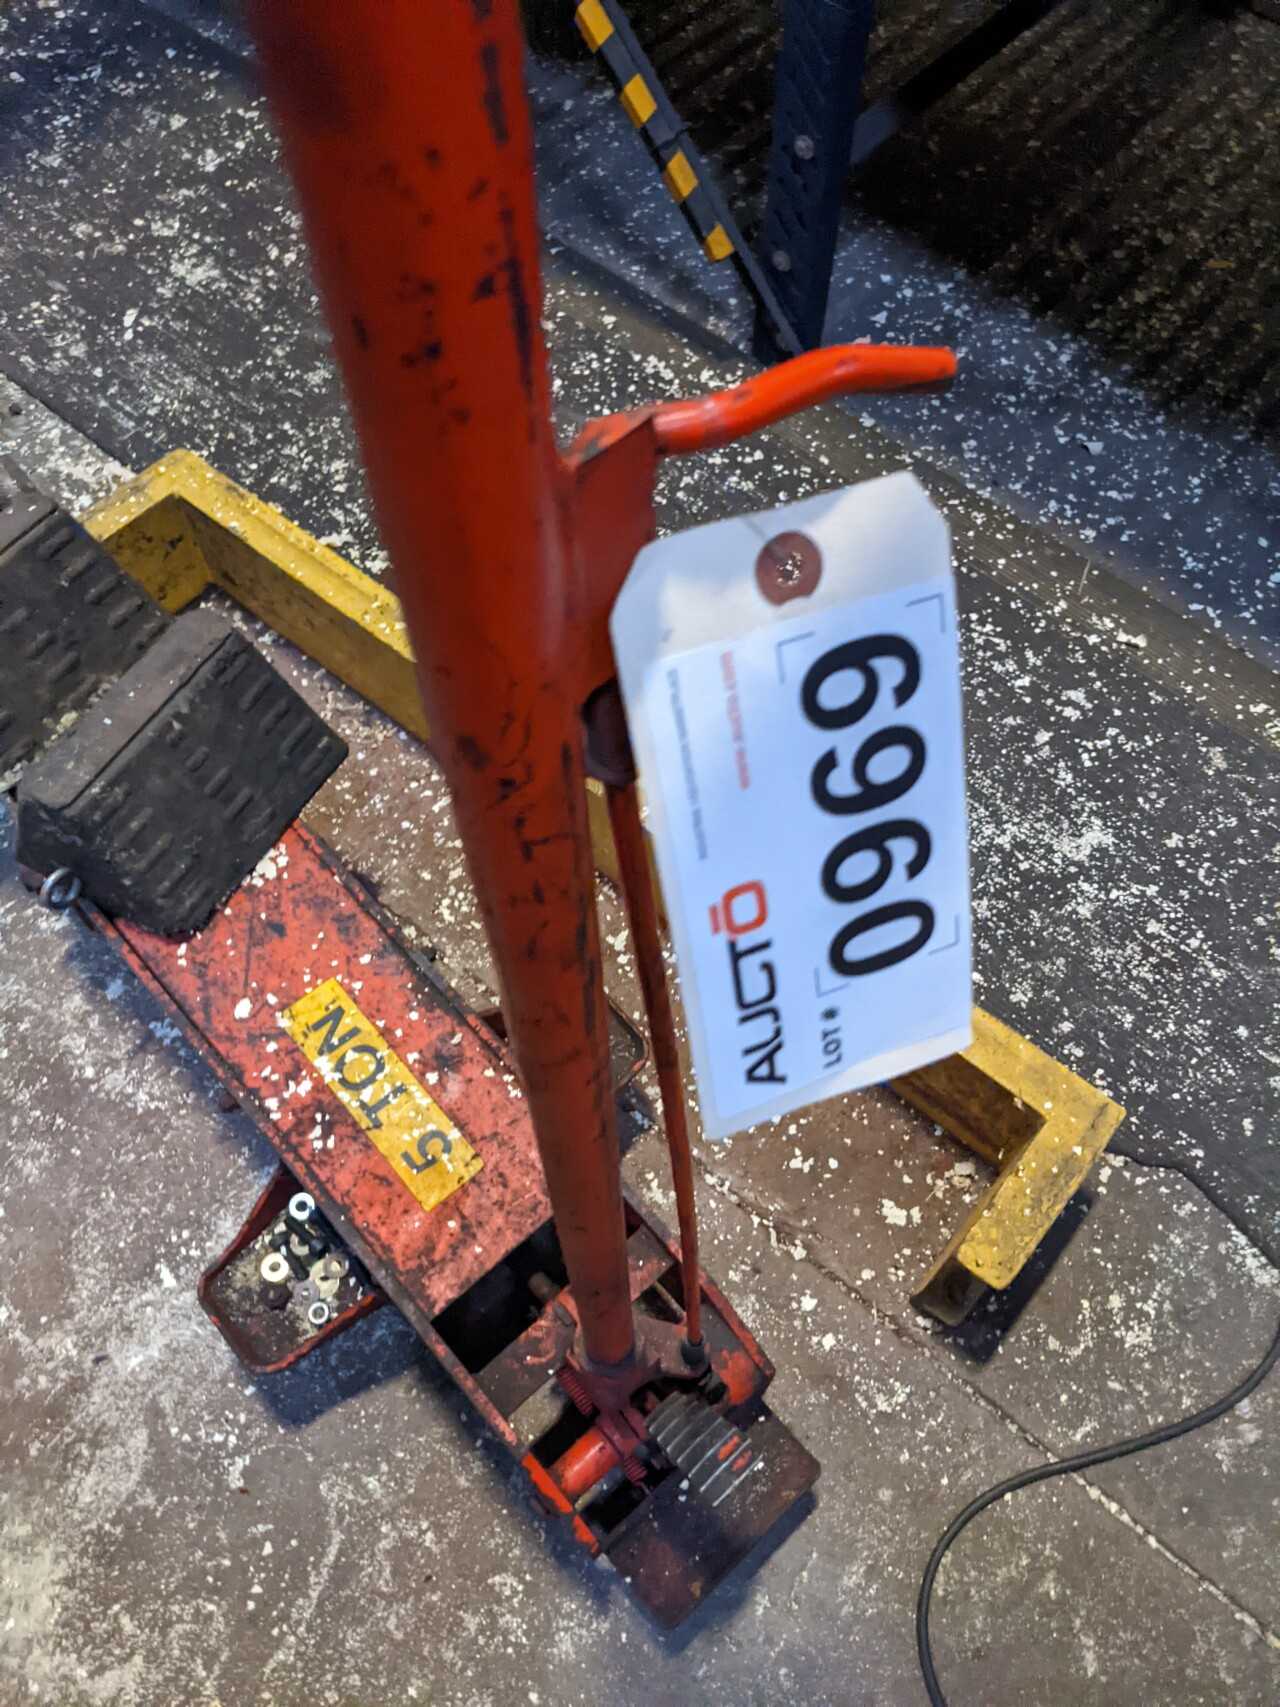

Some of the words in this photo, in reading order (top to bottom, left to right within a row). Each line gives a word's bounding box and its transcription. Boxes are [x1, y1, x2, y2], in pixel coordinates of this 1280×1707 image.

[801, 633, 936, 977] 0969
[821, 1007, 840, 1021] #
[311, 1006, 407, 1129] TON
[822, 1026, 843, 1069] LOT
[401, 1129, 453, 1174] 5
